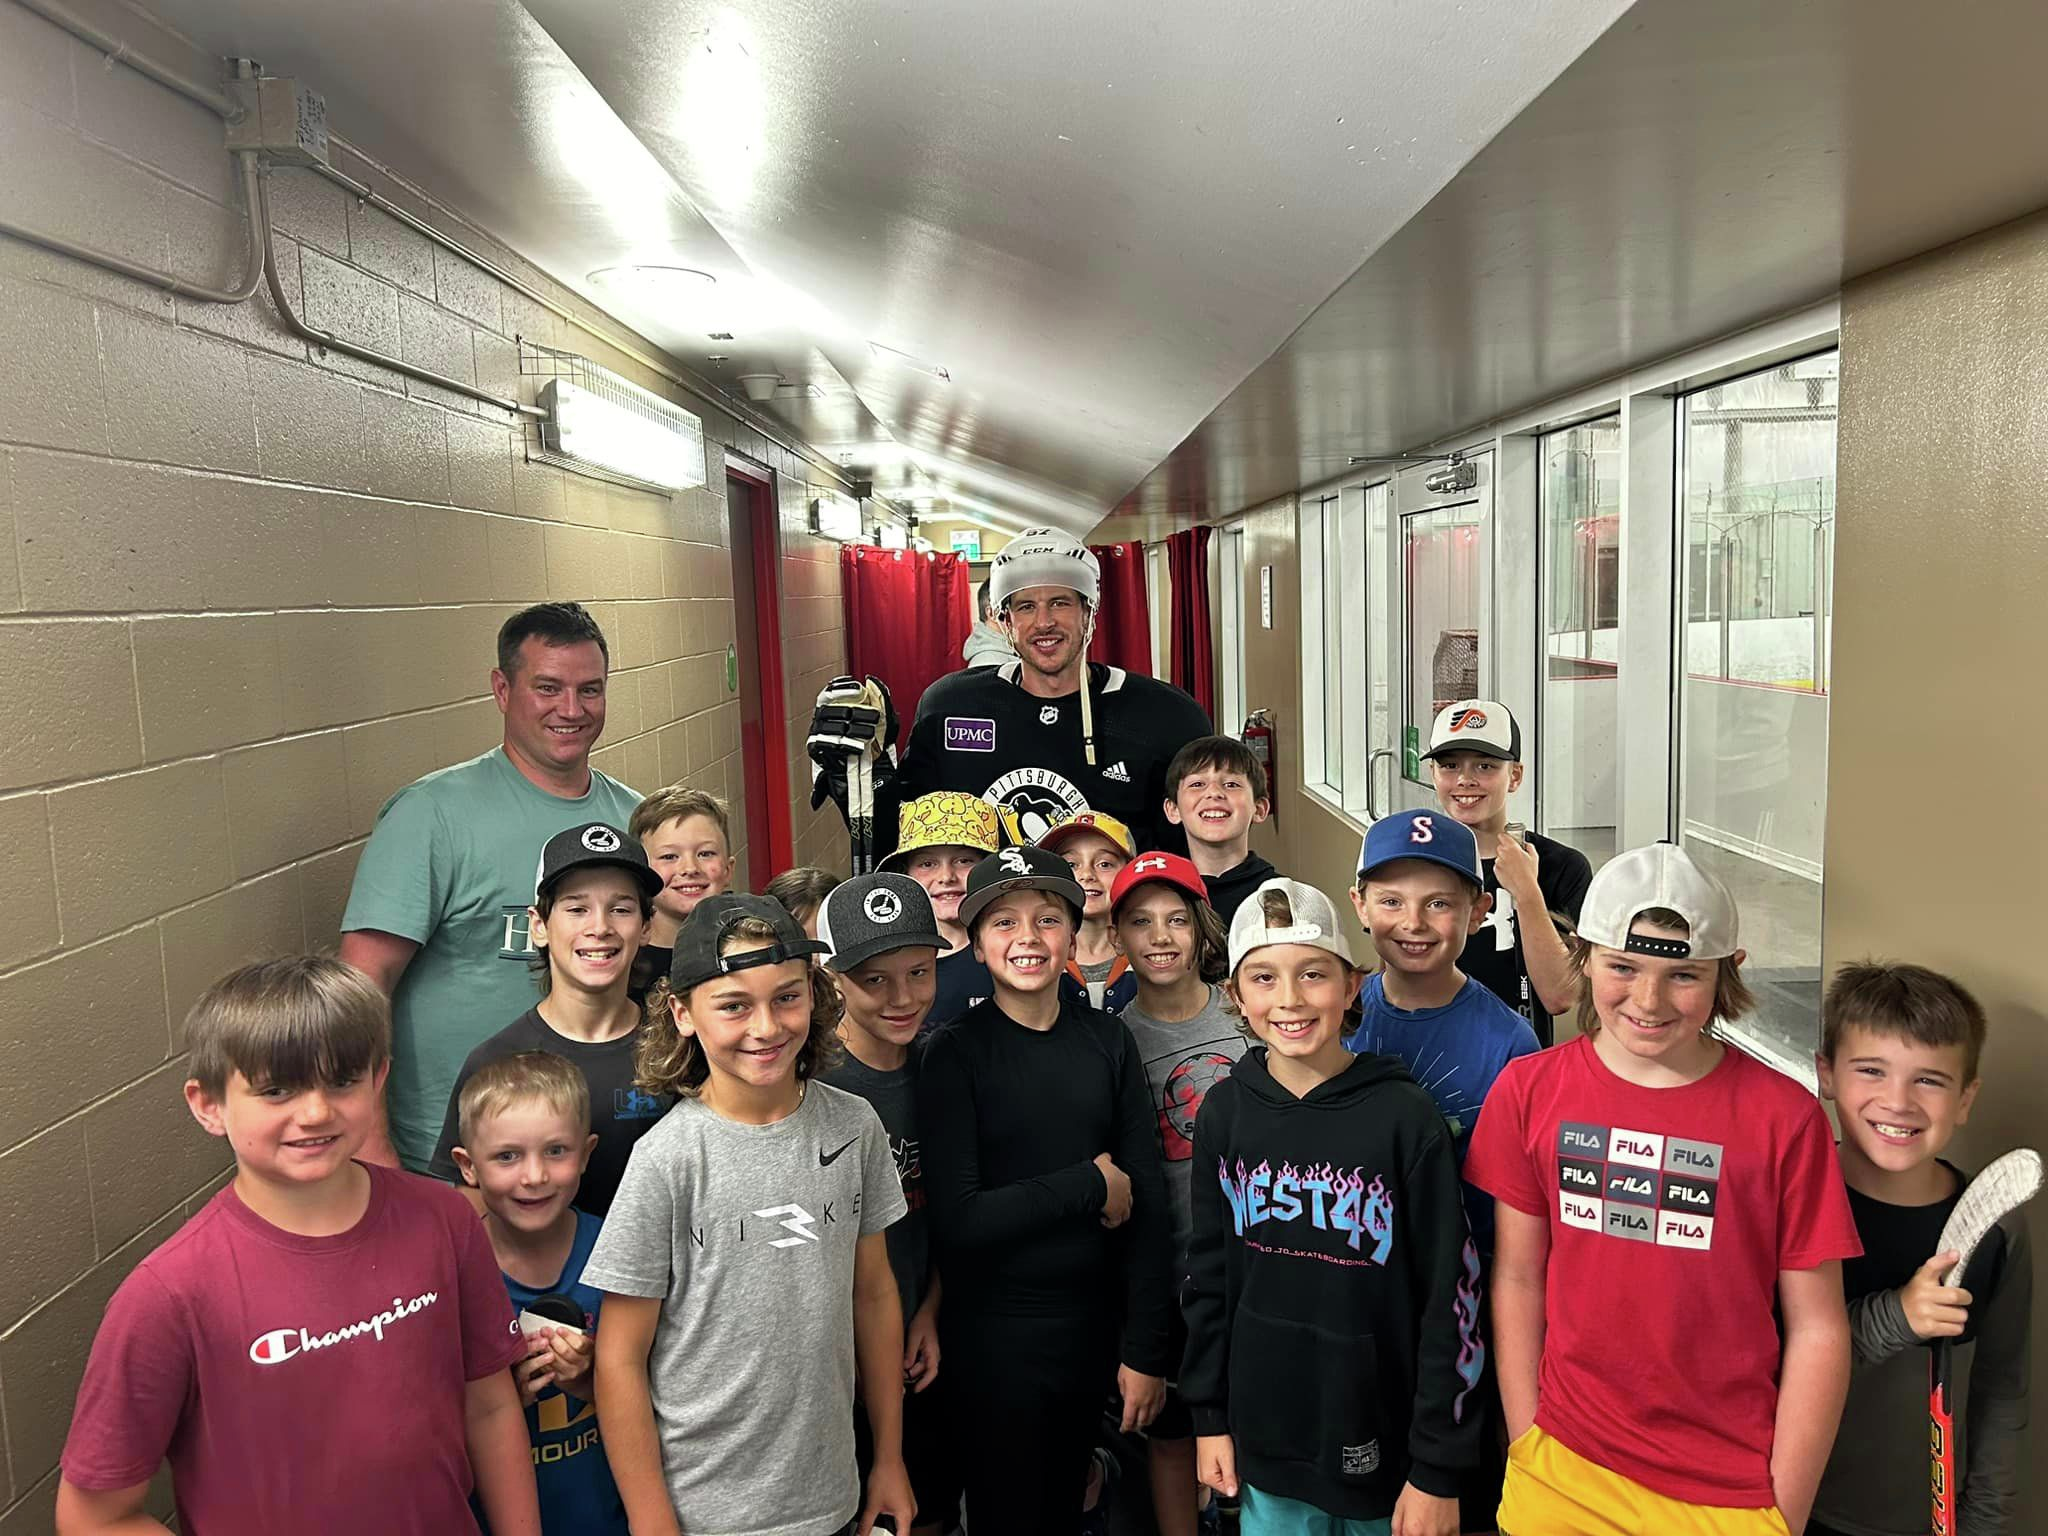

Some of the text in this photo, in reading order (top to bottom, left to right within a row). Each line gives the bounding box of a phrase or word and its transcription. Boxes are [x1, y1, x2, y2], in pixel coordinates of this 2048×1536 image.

[947, 727, 993, 742] UPMC
[1102, 770, 1131, 783] adidas
[988, 769, 1086, 811] PITTSBURGH
[1411, 816, 1433, 844] S
[1564, 1131, 1601, 1149] FILA
[1616, 1139, 1655, 1157] FILA
[1673, 1149, 1715, 1168] FILA
[1562, 1166, 1597, 1186] FILA
[1609, 1175, 1653, 1195] FILA
[1668, 1185, 1711, 1205] FILA
[1564, 1202, 1597, 1220] FILA
[1609, 1212, 1649, 1231] FILA
[1665, 1222, 1705, 1239] FILA
[249, 1291, 438, 1365] Champion
